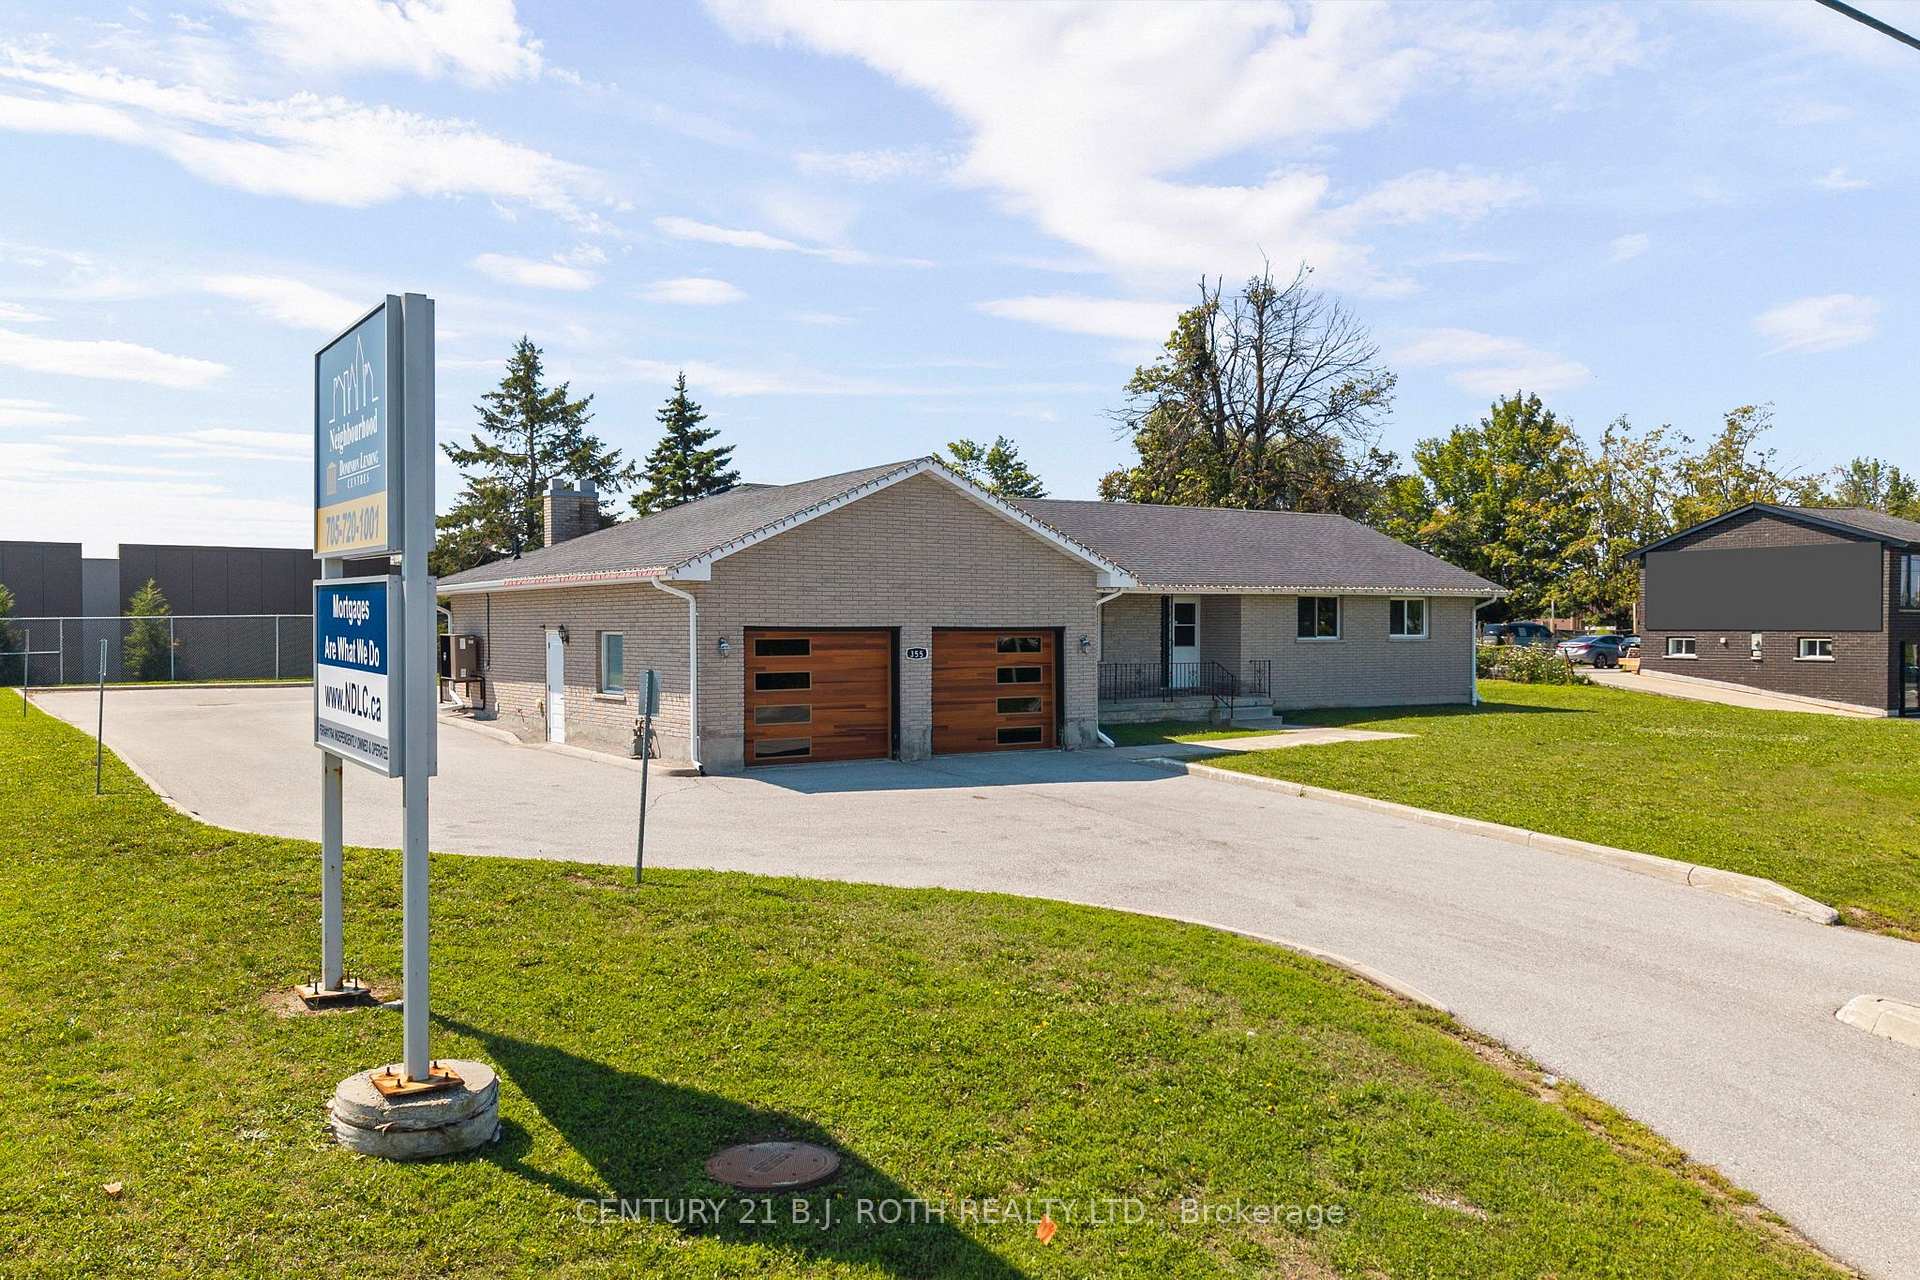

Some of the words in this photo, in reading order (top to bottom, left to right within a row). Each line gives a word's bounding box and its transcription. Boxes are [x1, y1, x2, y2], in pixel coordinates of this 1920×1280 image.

[329, 408, 378, 454] Neighbourhood
[326, 504, 379, 546] 705-720-1001
[332, 593, 370, 627] Mortgages
[324, 635, 337, 660] Are
[337, 636, 356, 663] What
[356, 638, 368, 665] We
[368, 639, 380, 667] Do
[324, 681, 382, 723] www.NDLC.ca
